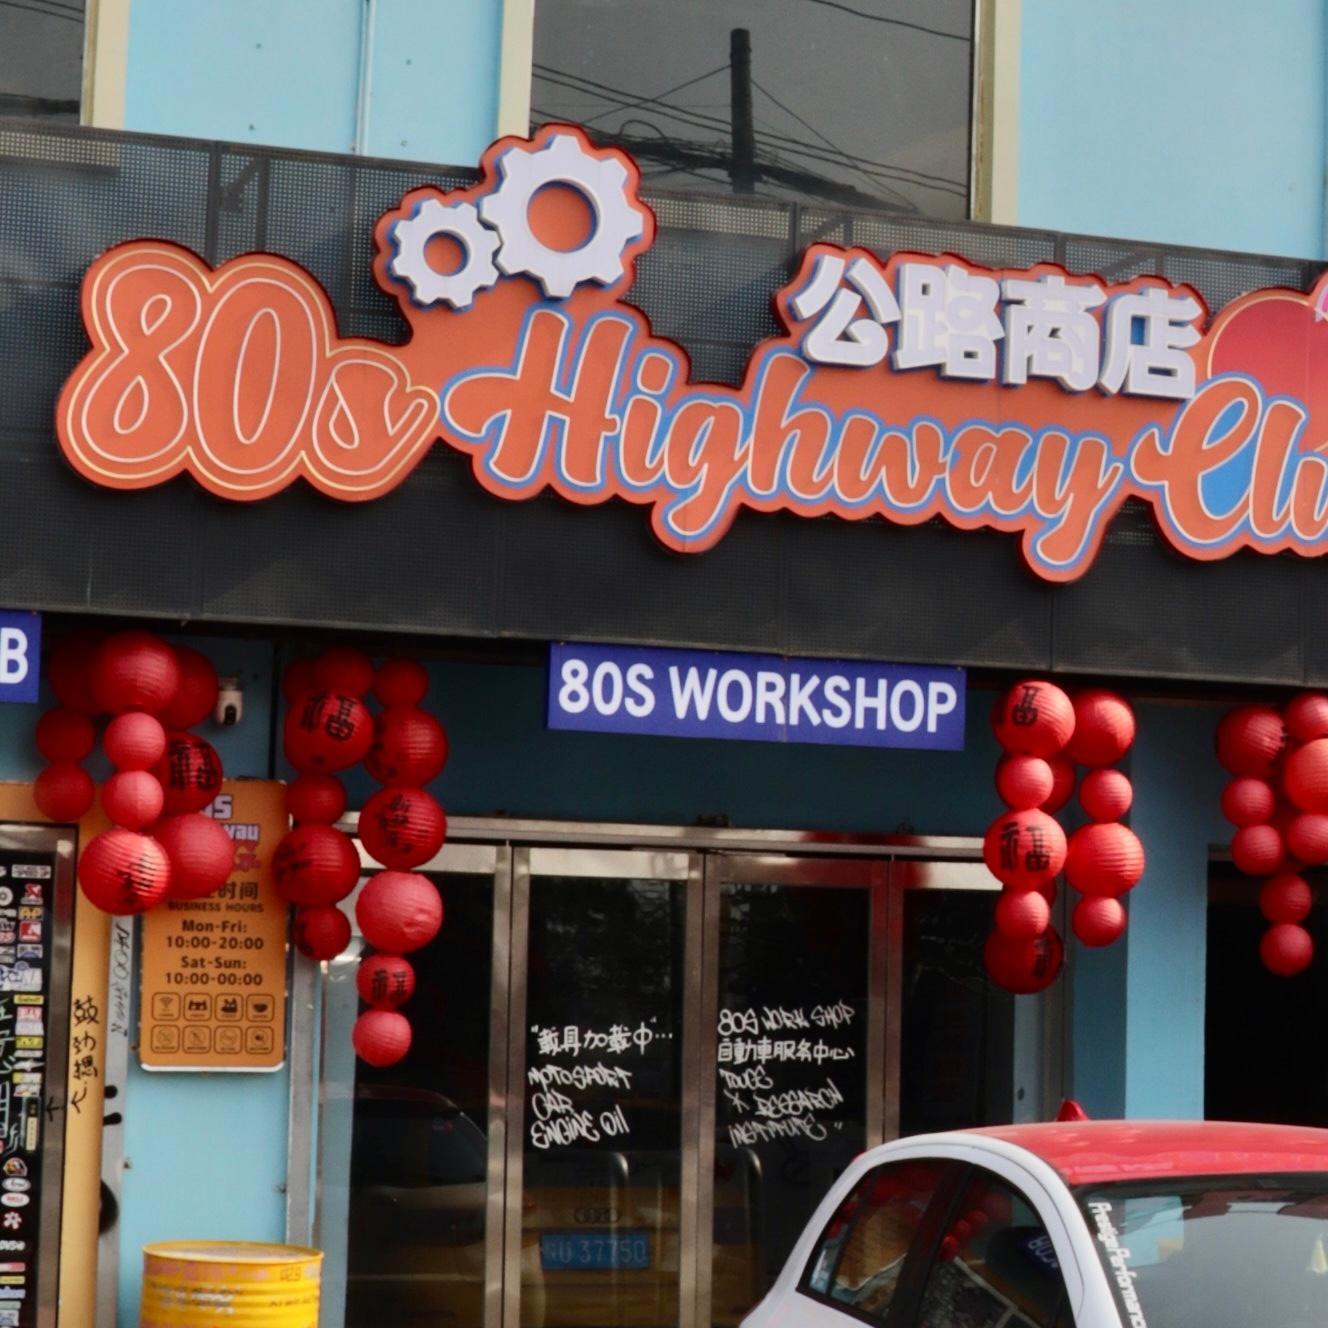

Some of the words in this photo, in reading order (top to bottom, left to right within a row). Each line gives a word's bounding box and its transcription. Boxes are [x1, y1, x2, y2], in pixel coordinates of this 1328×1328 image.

[793, 254, 1205, 402] 公路商店
[74, 256, 440, 482] 80s
[443, 308, 1124, 566] Highway
[558, 660, 656, 718] 80S
[670, 665, 959, 735] WORKSHOP
[999, 821, 1051, 873] 福
[168, 900, 221, 913] BUSINESS
[225, 901, 264, 913] HOURS
[181, 919, 248, 933] Mon-Fri:
[165, 935, 265, 950] 10:00-20:00
[180, 955, 248, 969] Sat-Sun:
[165, 972, 263, 986] 10:00-00:00
